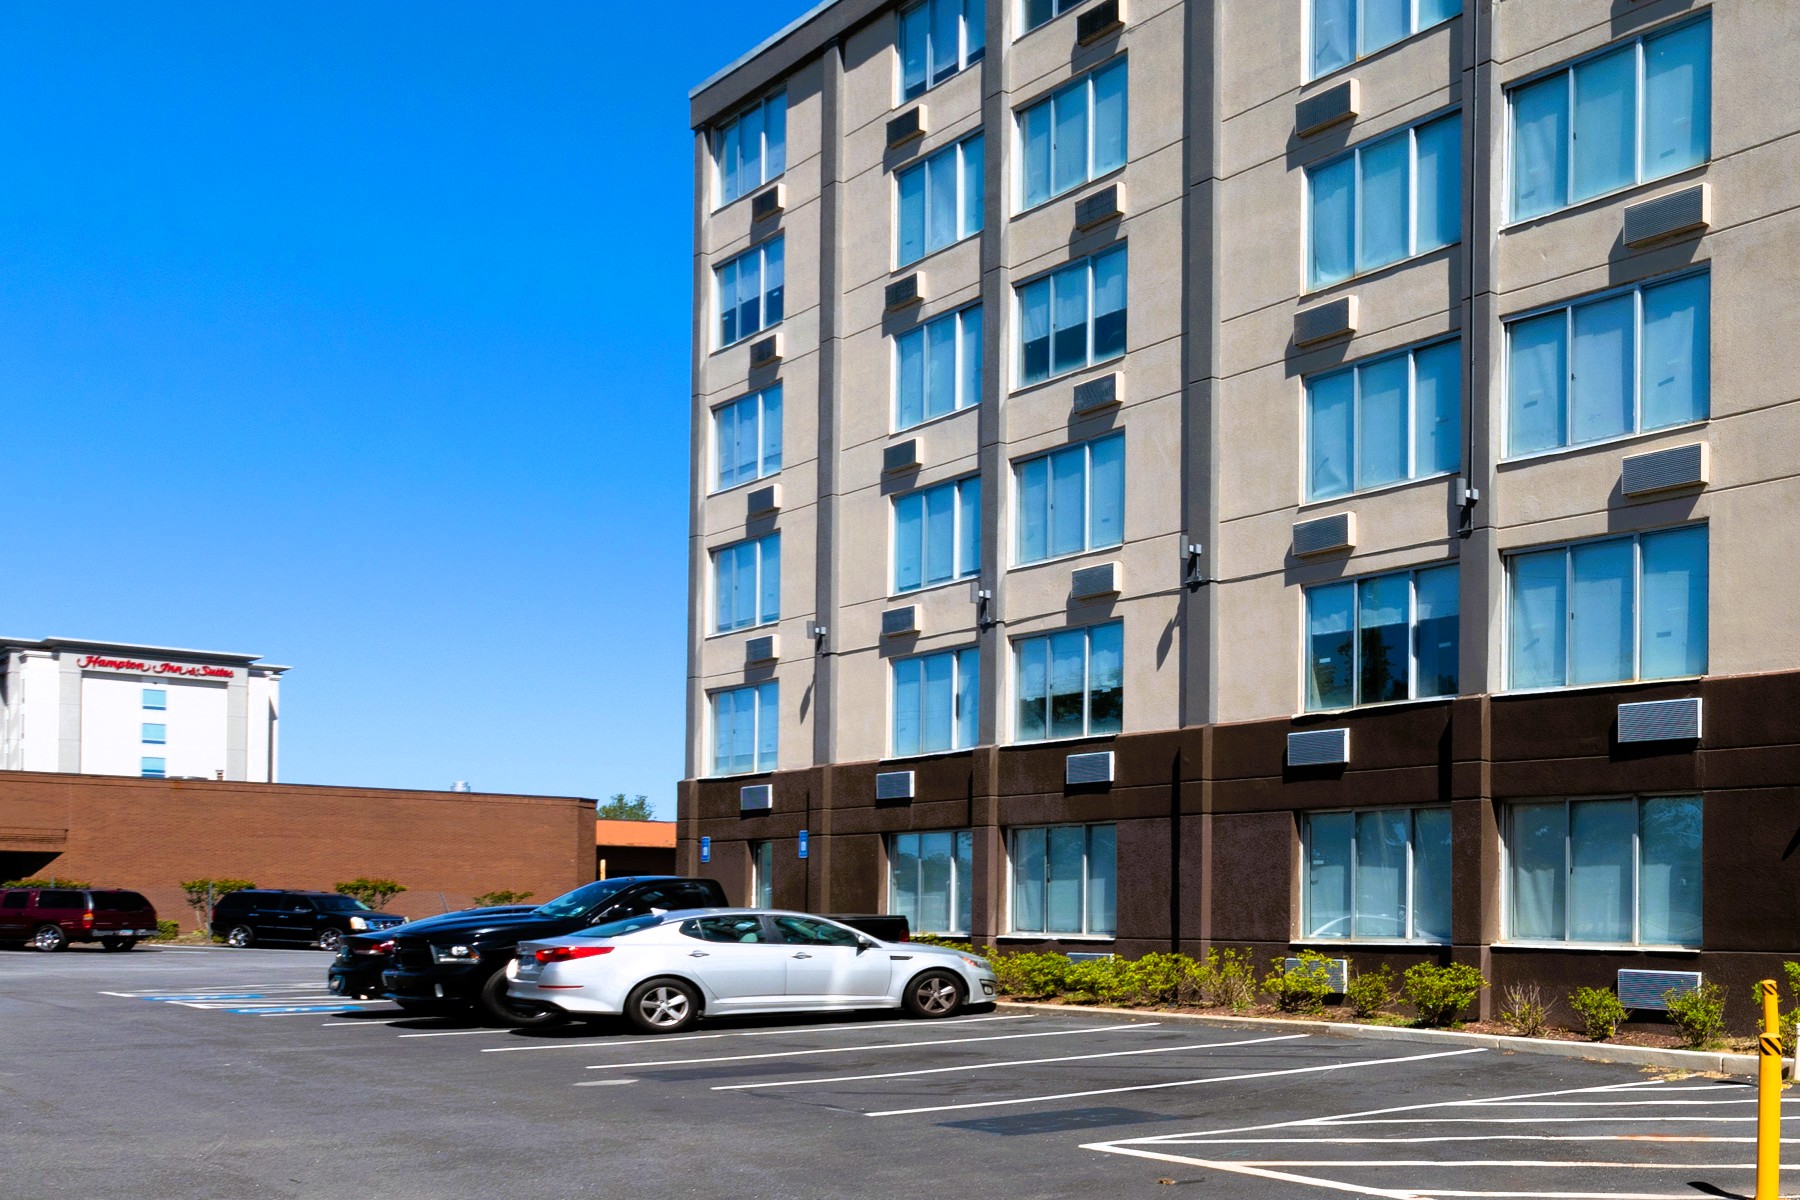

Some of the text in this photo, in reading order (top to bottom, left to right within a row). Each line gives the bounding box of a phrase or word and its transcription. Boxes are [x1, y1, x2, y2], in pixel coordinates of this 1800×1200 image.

[76, 655, 150, 672] Hampton
[152, 661, 187, 675] Inn
[196, 666, 235, 678] Suites
